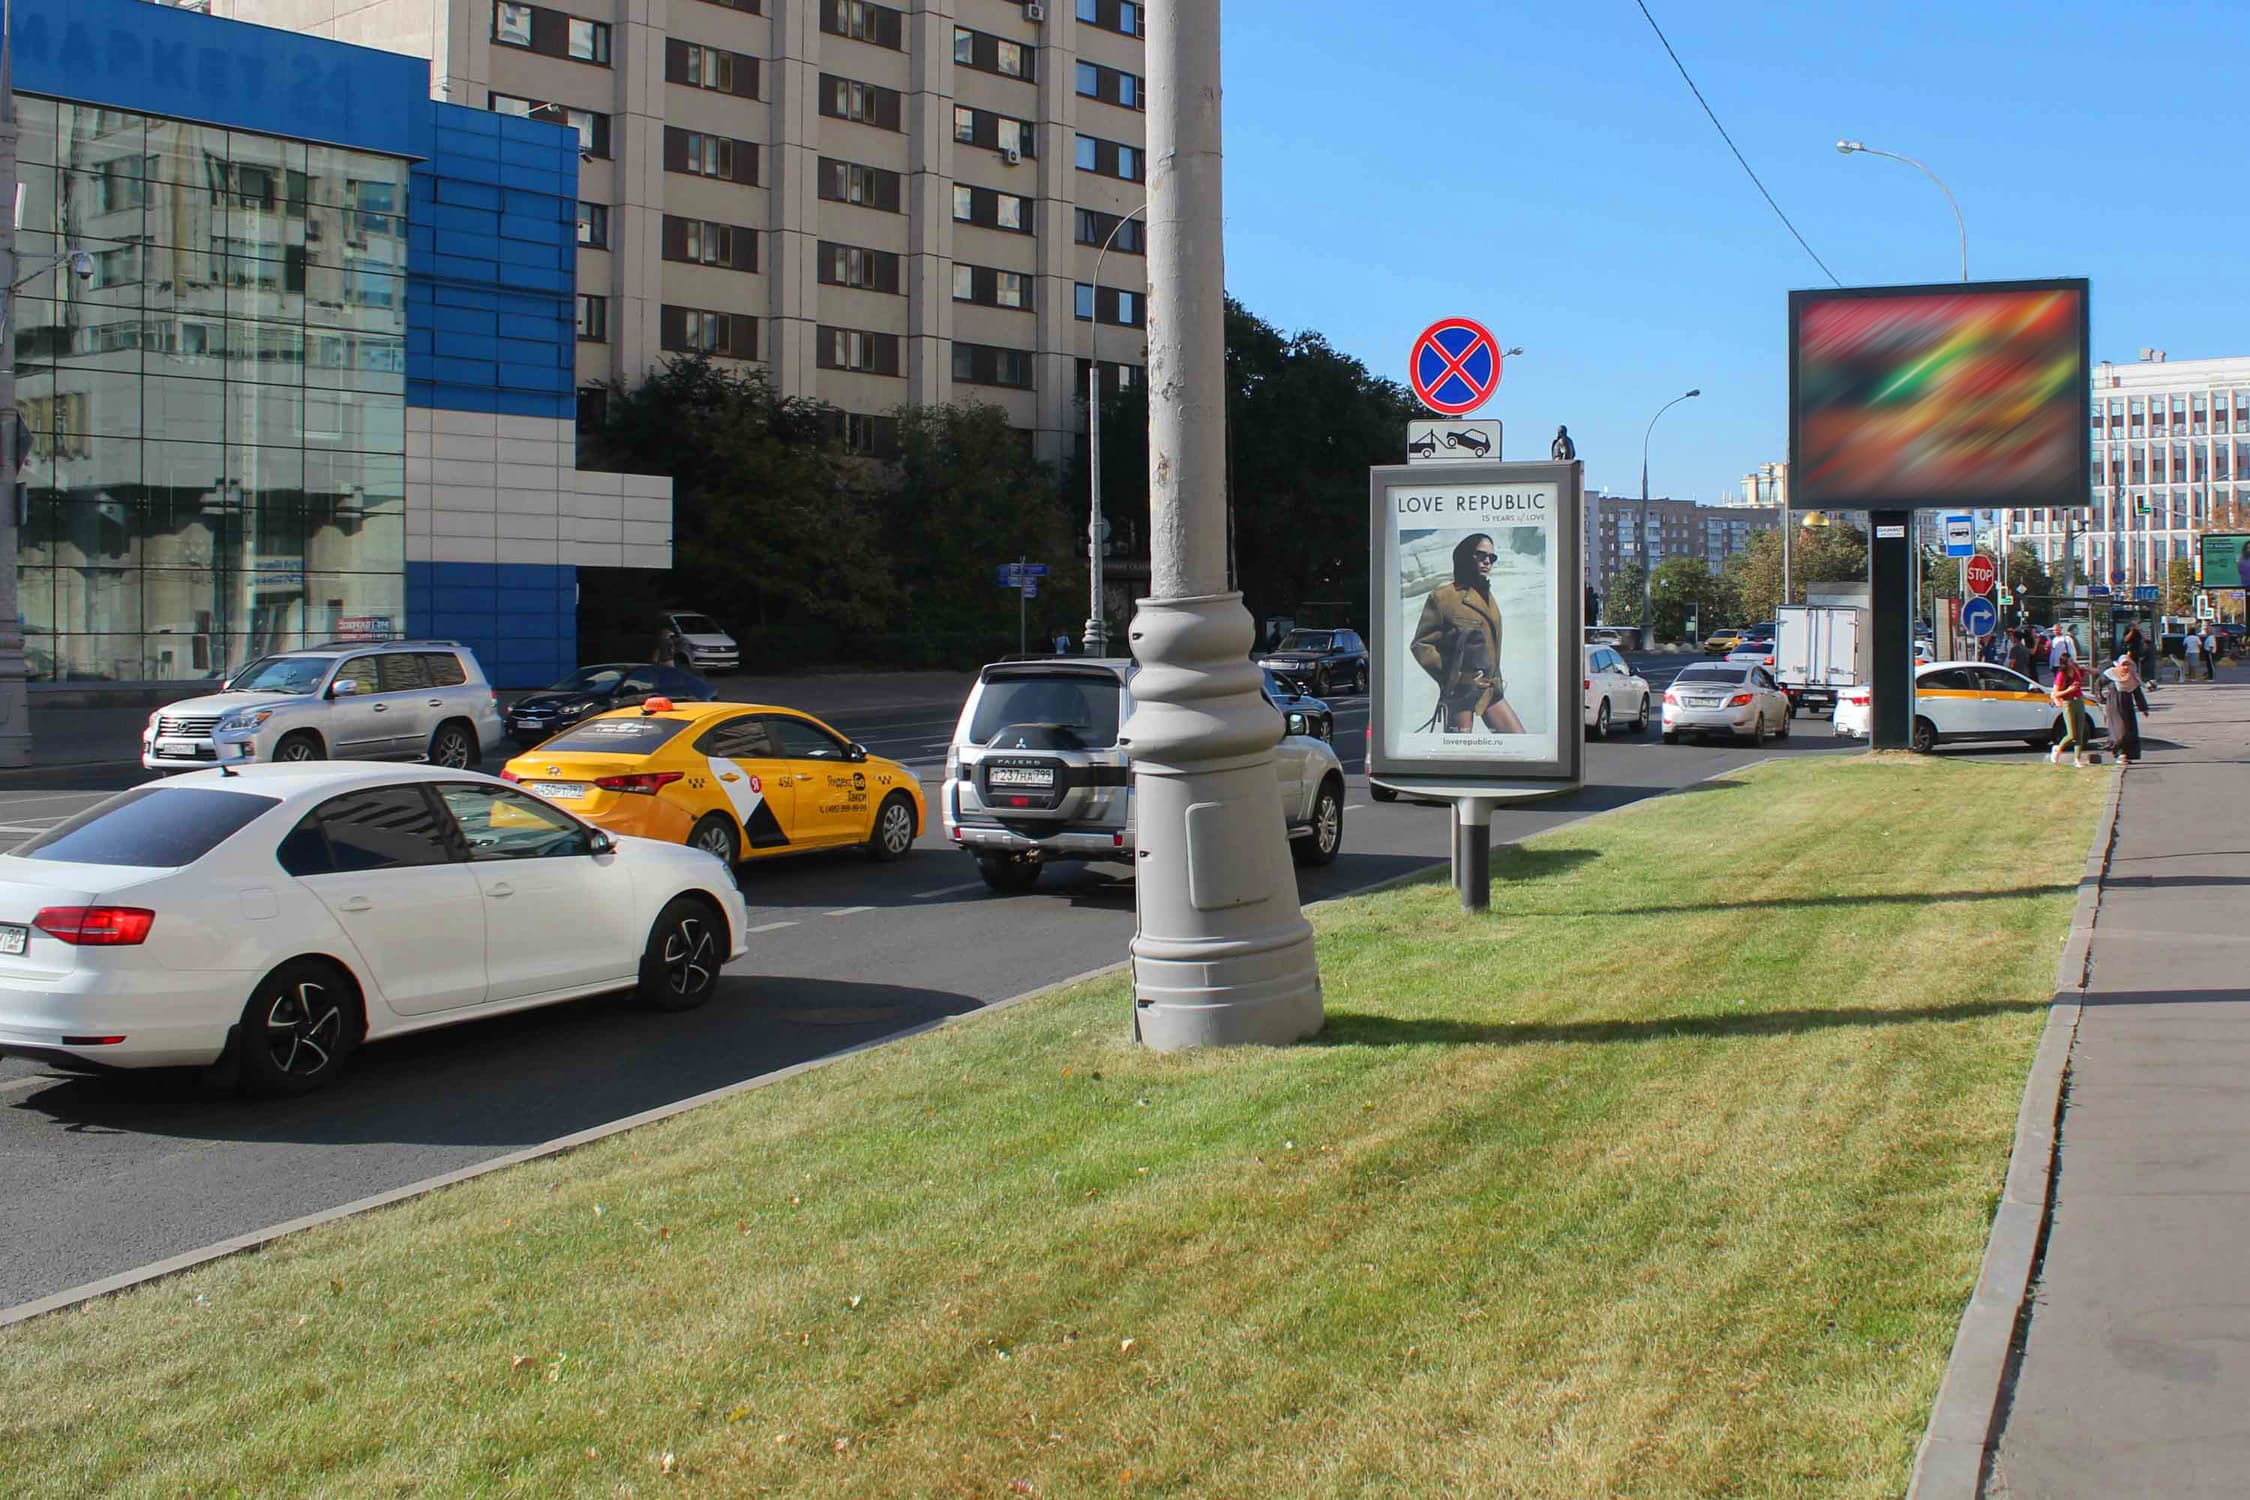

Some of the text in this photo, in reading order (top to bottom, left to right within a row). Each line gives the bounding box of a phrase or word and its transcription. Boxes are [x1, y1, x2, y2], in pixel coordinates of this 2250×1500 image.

[1398, 493, 1545, 513] LOVE REPUBLIC
[1492, 514, 1515, 522] YEARS
[1526, 513, 1545, 522] LOVE
[1967, 567, 1993, 581] STOP
[1442, 737, 1504, 747] loverepublic.ru
